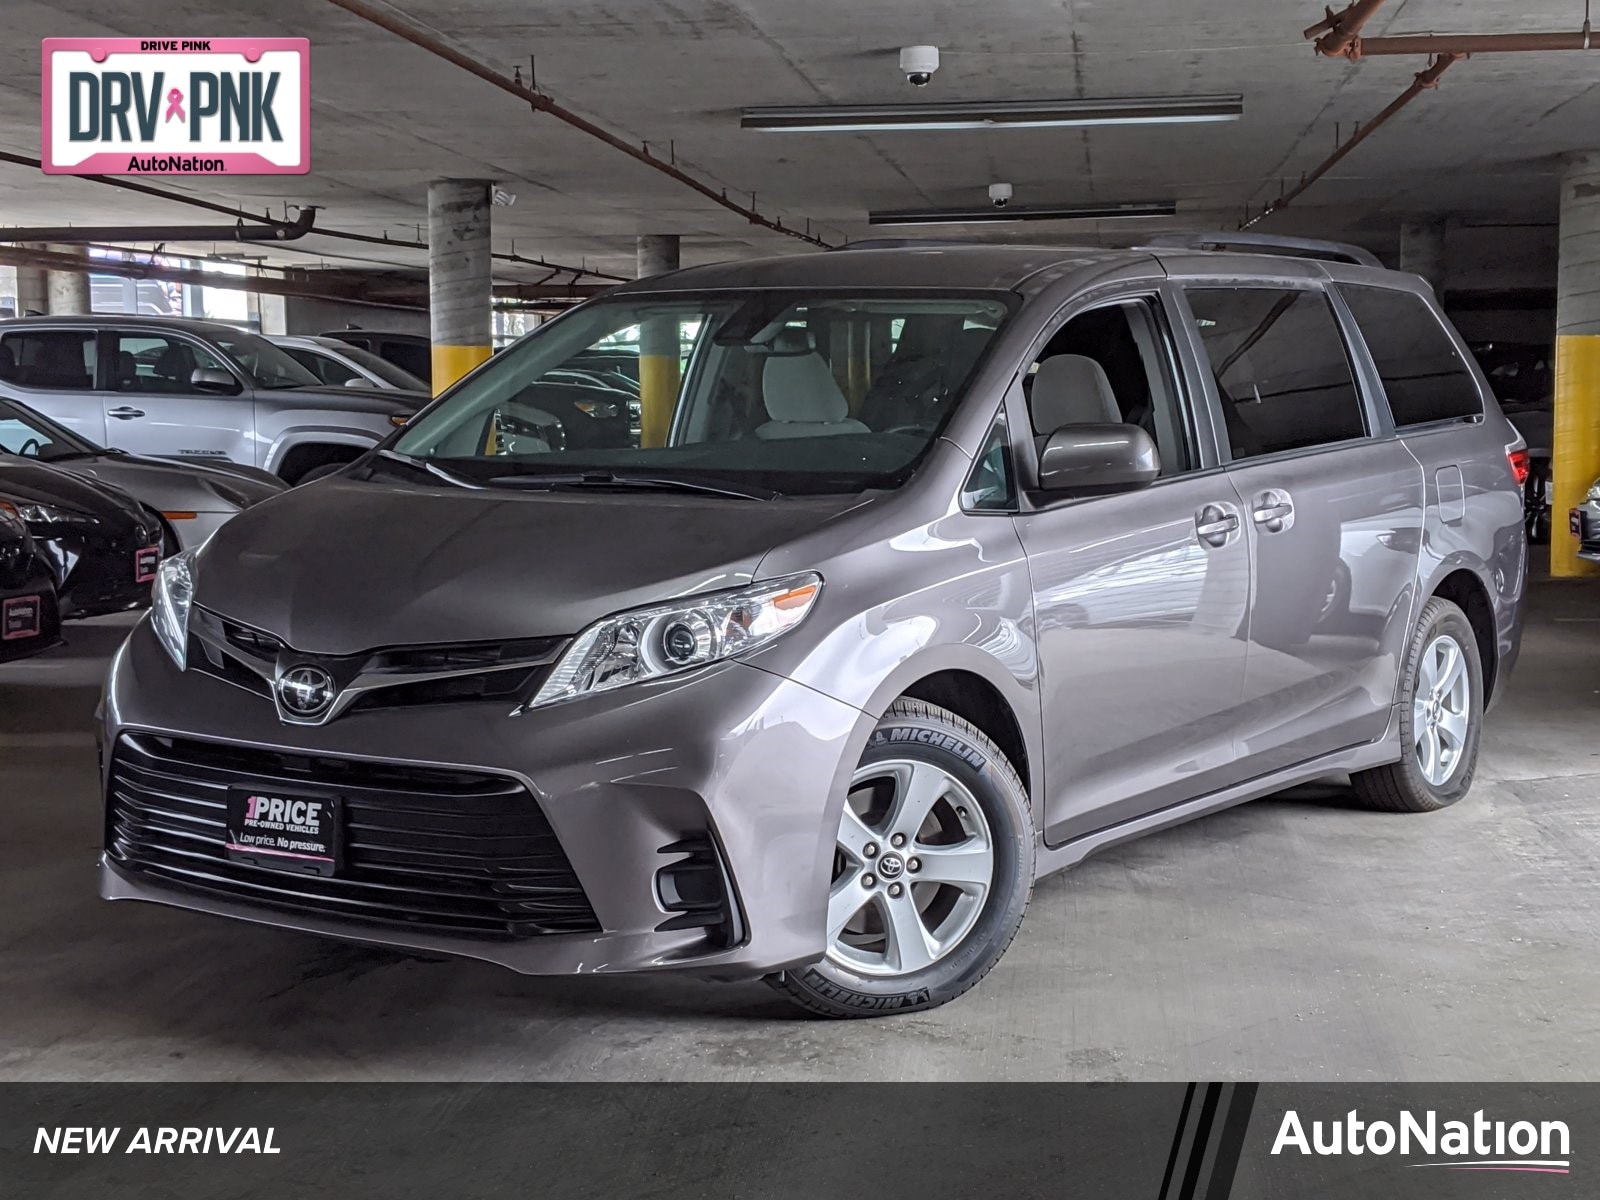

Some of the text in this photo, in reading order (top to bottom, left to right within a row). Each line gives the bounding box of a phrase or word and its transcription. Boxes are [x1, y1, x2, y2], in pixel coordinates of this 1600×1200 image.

[889, 728, 986, 768] MICHELIN
[245, 795, 322, 826] 1PRICE
[244, 819, 319, 834] PRE-OWNED VEHICLES
[240, 832, 326, 853] Low price. No pressure.
[803, 973, 904, 1009] MICHELIN
